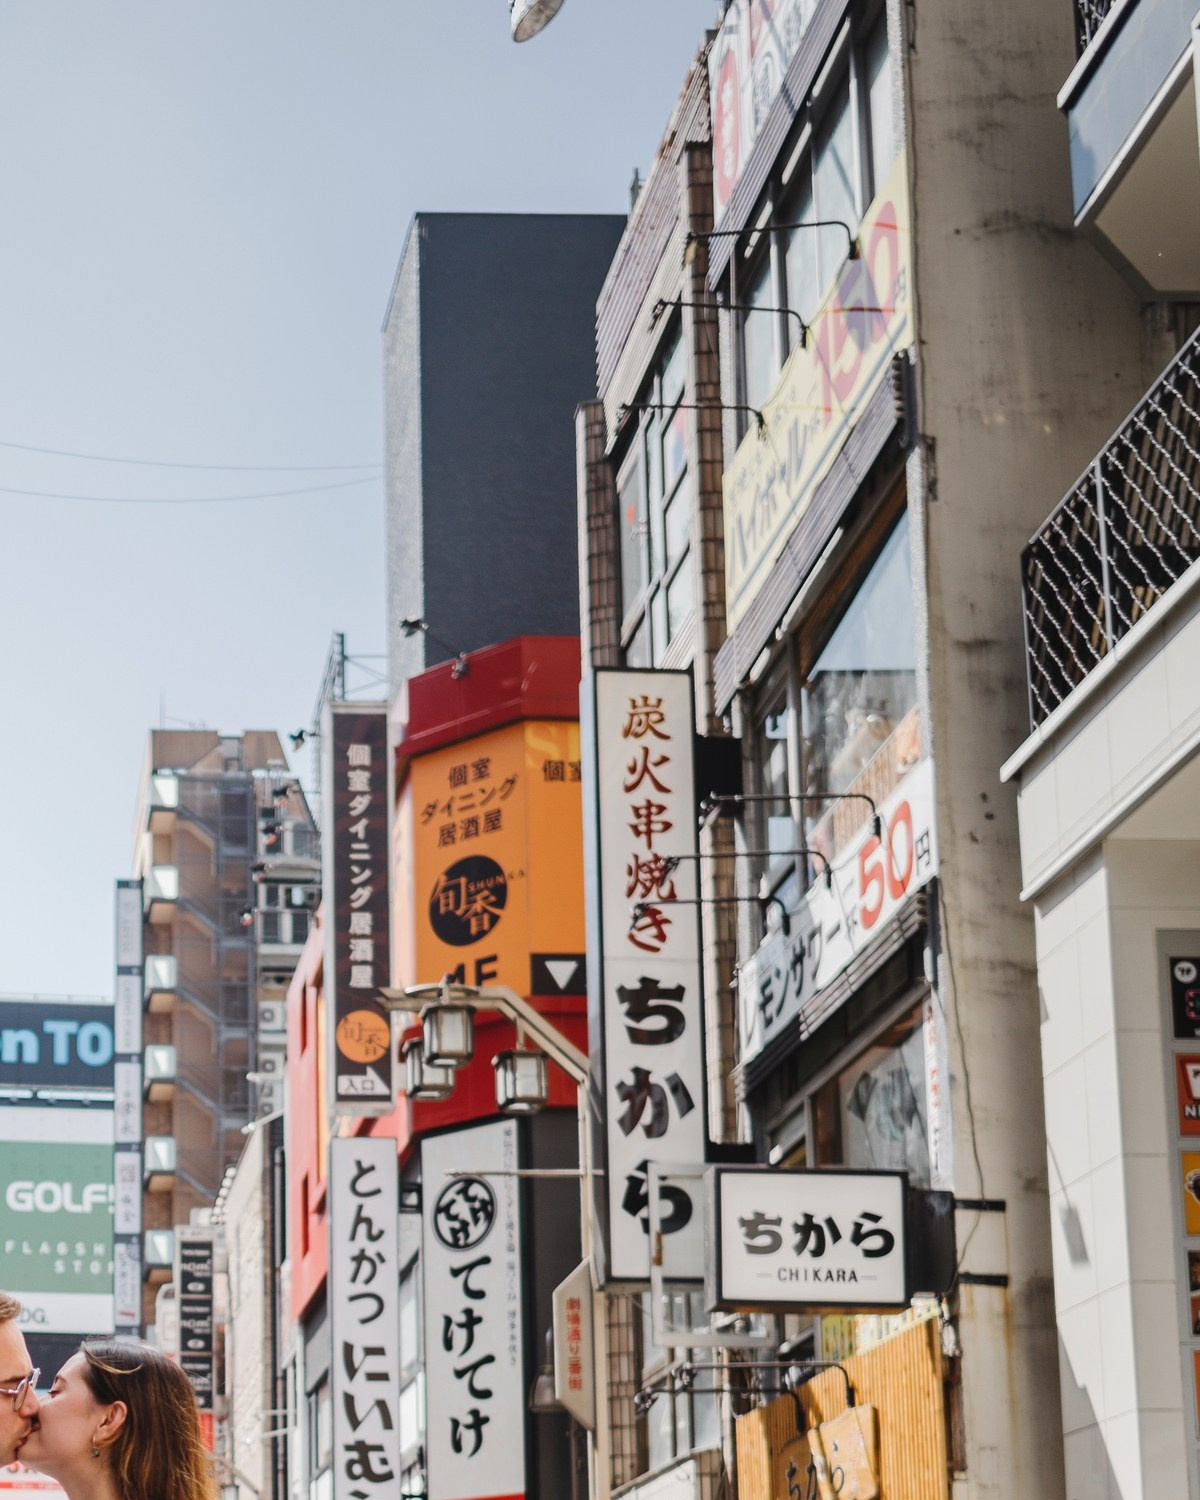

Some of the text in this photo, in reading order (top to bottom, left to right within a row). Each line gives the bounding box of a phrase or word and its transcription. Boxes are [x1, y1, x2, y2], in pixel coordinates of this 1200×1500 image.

[420, 773, 520, 826] ダイニング
[448, 757, 493, 789] 個室
[438, 809, 503, 848] 居酒屋
[346, 743, 375, 989] 個室ダイニング居酒屋
[615, 694, 695, 1238] 炭火串焼き ちから
[345, 1079, 375, 1092] 入口
[347, 1158, 386, 1325] とんかつ
[738, 1210, 896, 1258] ちから
[777, 1266, 858, 1284] CHIKARA
[441, 1255, 494, 1459] てけてけ
[565, 1296, 583, 1392] 劇場通り一番街
